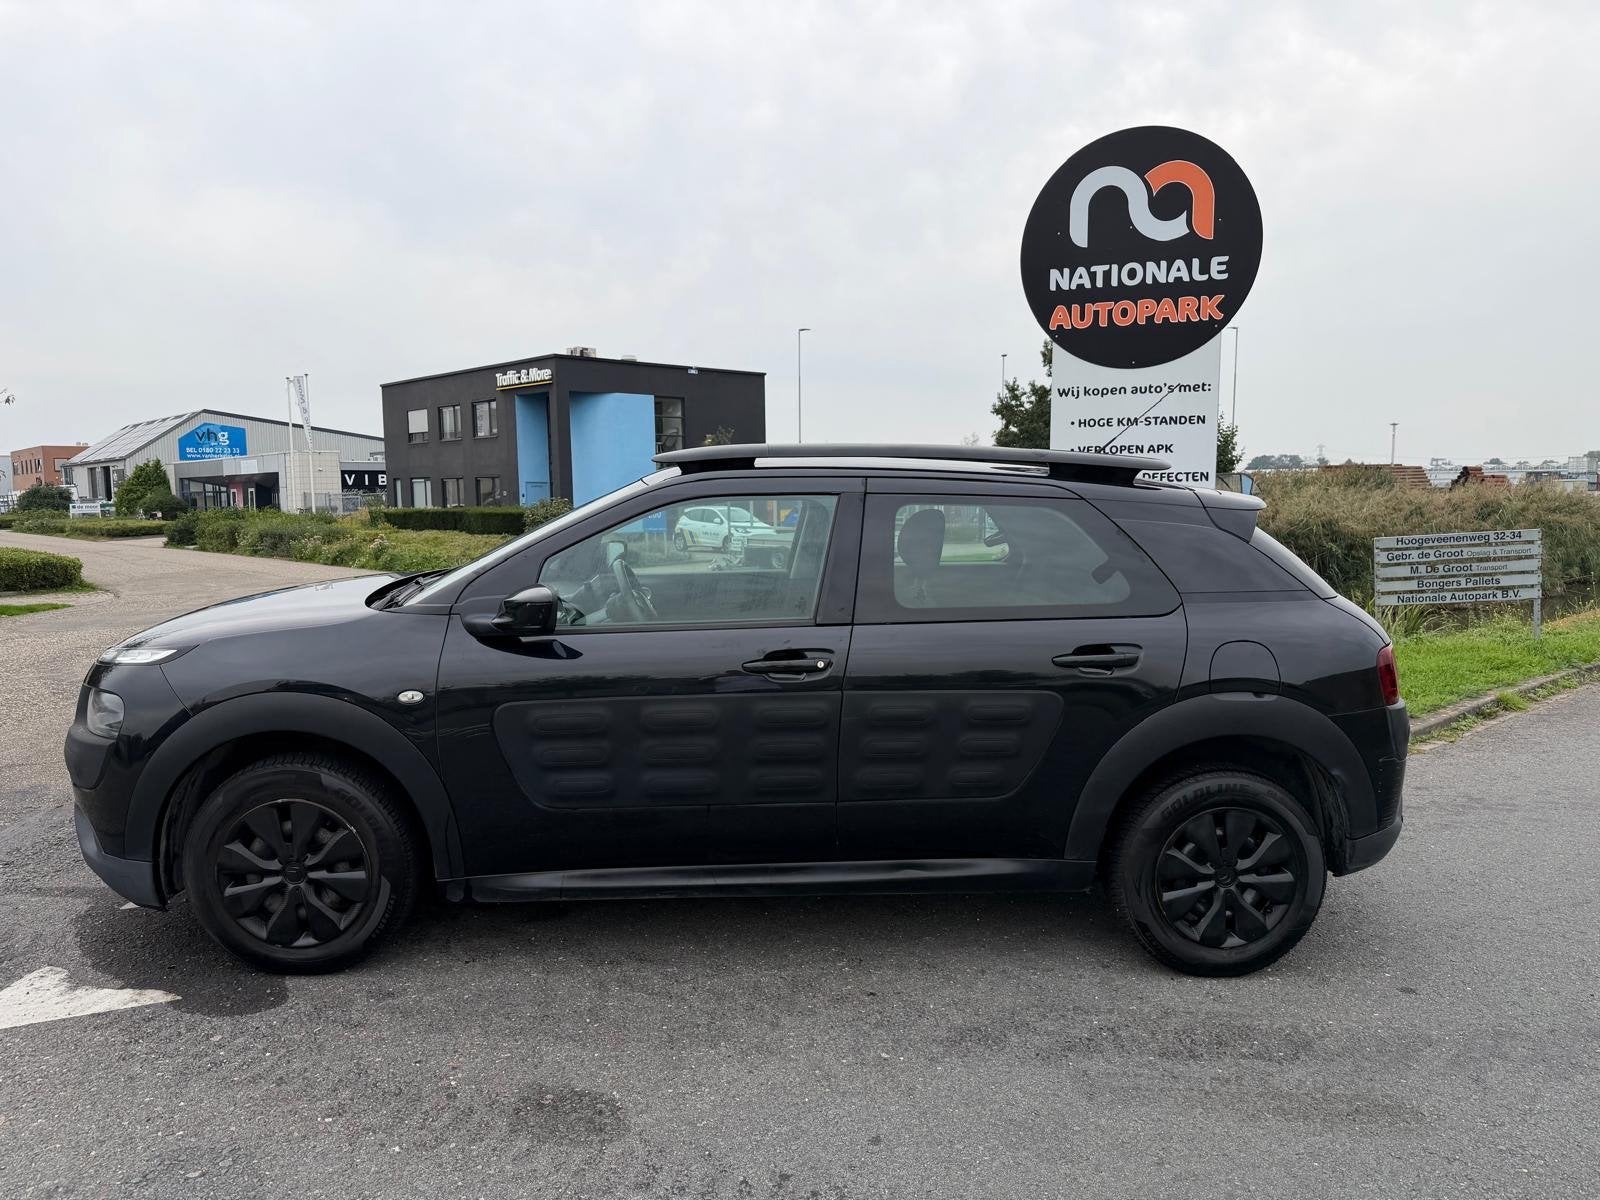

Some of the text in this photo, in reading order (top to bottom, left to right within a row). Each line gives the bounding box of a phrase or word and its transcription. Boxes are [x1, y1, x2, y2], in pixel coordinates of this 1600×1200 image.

[1049, 255, 1230, 292] NATIONALE
[1049, 294, 1226, 331] AUTOPARK
[495, 370, 520, 387] Traffic
[1057, 387, 1081, 400] Wij
[1083, 385, 1127, 399] kopen
[1178, 381, 1213, 394] met:
[1077, 415, 1206, 429] HOGE KM-STANDEN
[195, 428, 230, 446] vhg
[1147, 443, 1174, 454] APK
[1396, 531, 1522, 546] Hoogeveenenweg 32-34
[1386, 552, 1415, 562] Gebr.
[1417, 551, 1431, 560] de
[1433, 549, 1464, 558] Groot
[1500, 547, 1532, 556] Transport
[1410, 564, 1508, 575] M. De Groot Transport
[1417, 577, 1501, 590] Bongers Pallets
[1397, 589, 1522, 604] Nationale Autopark B.V.
